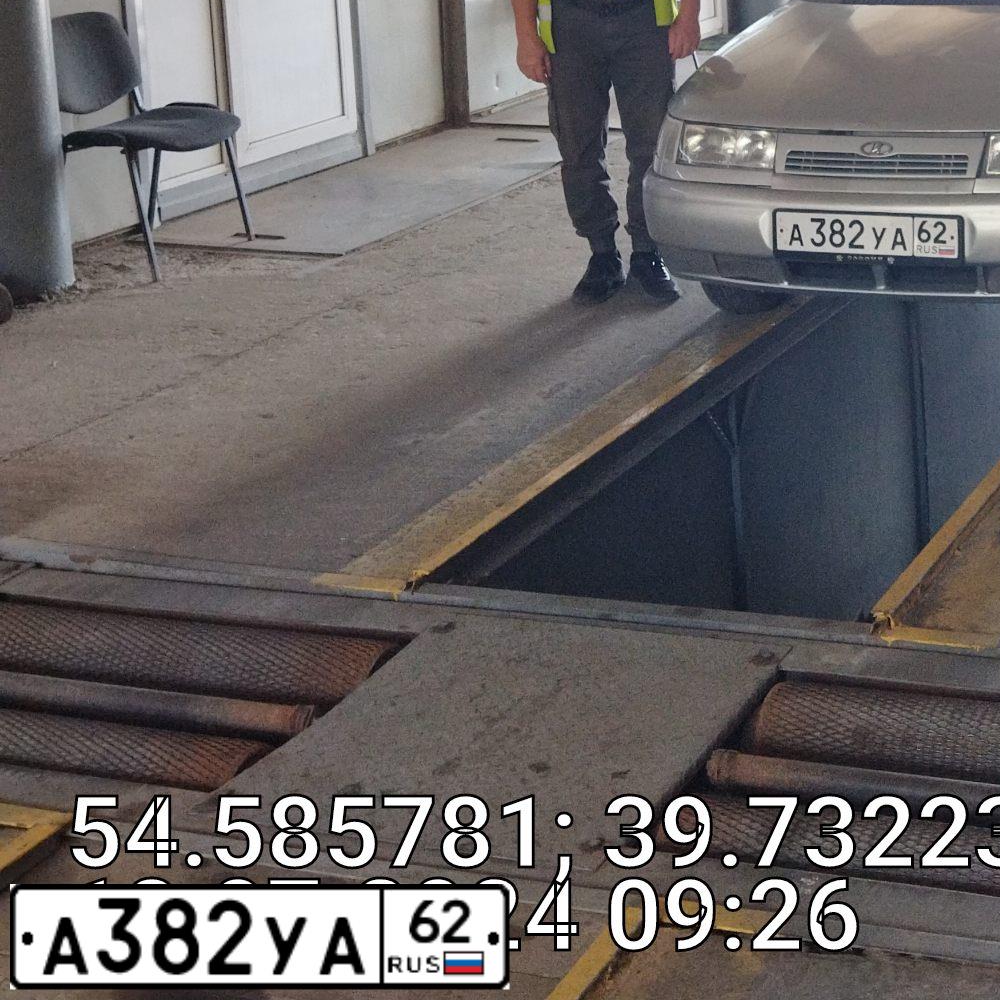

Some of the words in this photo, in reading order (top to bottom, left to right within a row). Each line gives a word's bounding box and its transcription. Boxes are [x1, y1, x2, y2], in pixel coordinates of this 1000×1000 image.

[788, 217, 907, 251] А382УА
[917, 220, 947, 244] 62
[916, 244, 939, 255] RUS
